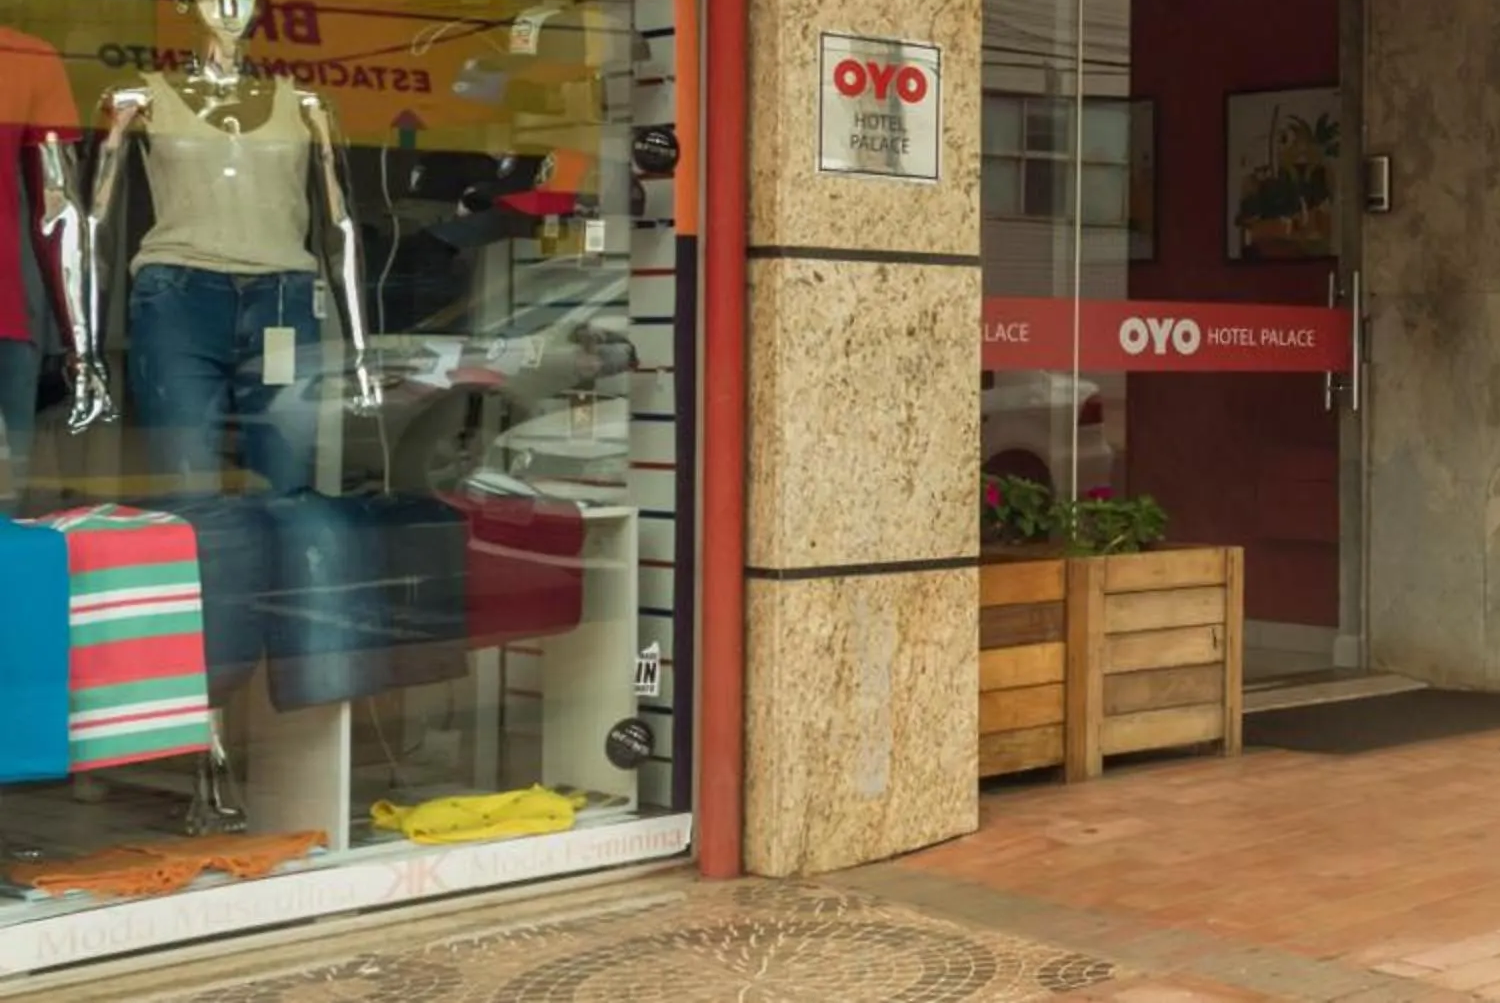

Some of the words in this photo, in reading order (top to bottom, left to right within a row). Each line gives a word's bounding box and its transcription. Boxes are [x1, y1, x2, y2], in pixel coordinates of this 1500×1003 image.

[833, 58, 927, 104] OYO
[854, 111, 907, 133] HOTEL
[850, 134, 910, 154] PALACE
[1119, 317, 1201, 355] OYO
[1207, 327, 1257, 346] HOTEL
[1260, 328, 1317, 347] PALACE
[635, 660, 658, 684] IN
